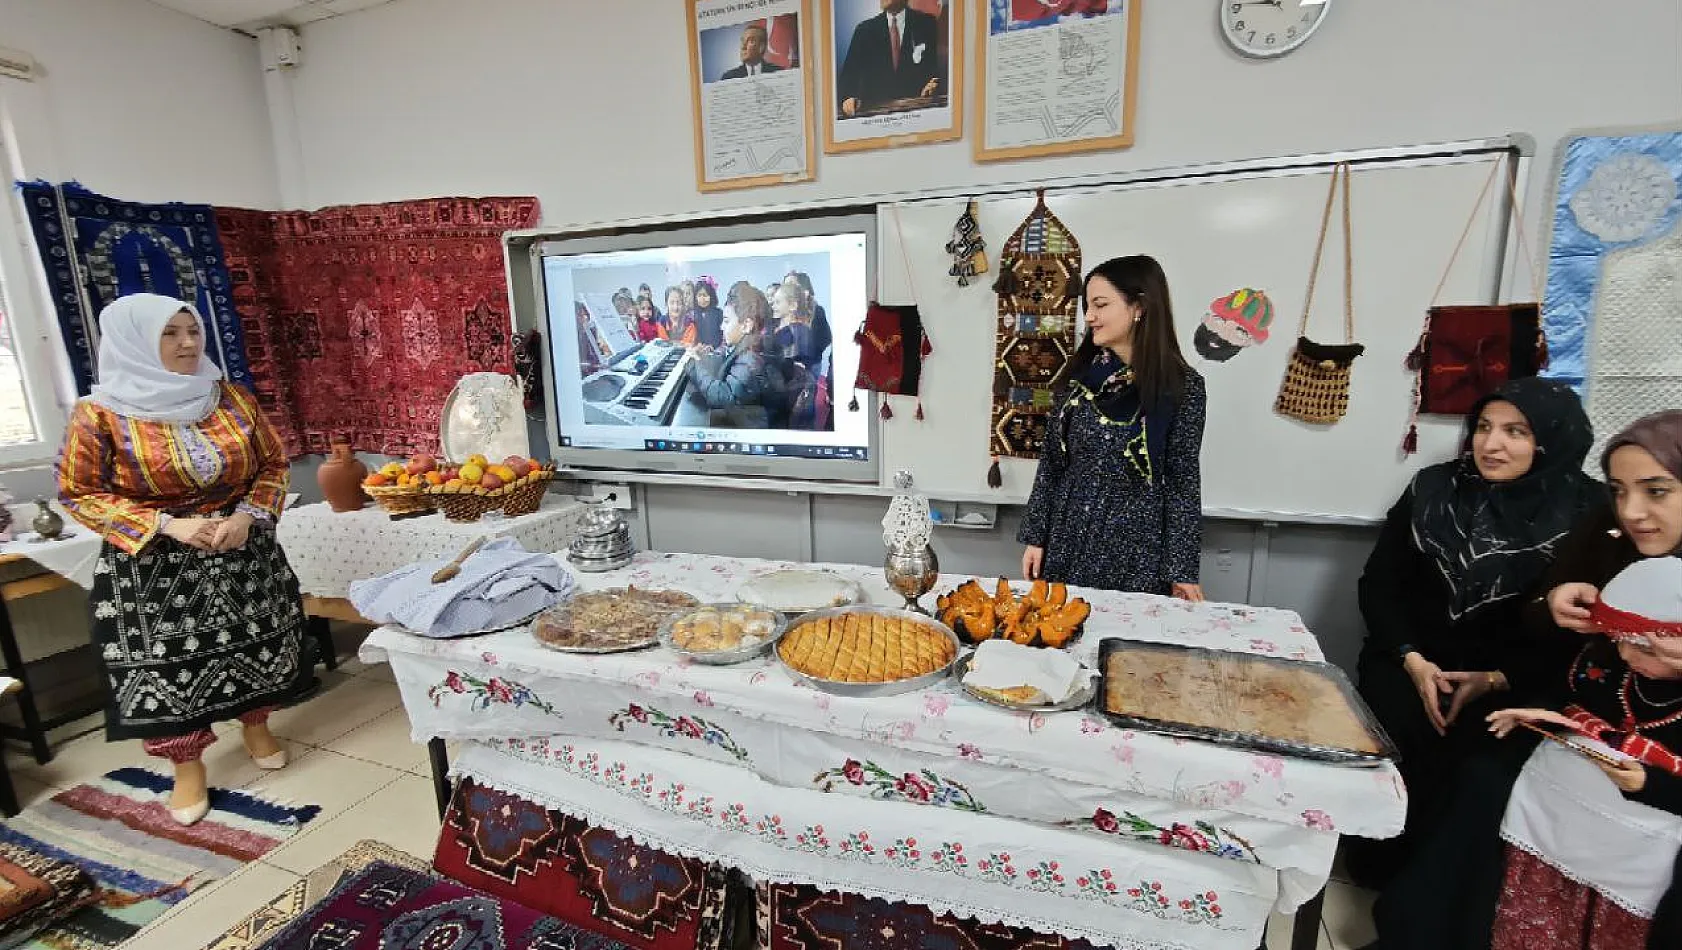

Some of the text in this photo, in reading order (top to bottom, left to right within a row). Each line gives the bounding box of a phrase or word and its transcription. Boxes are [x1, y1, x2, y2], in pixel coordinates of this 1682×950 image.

[1235, 21, 1245, 31] 8
[1248, 31, 1256, 42] 7
[1265, 33, 1275, 44] 6
